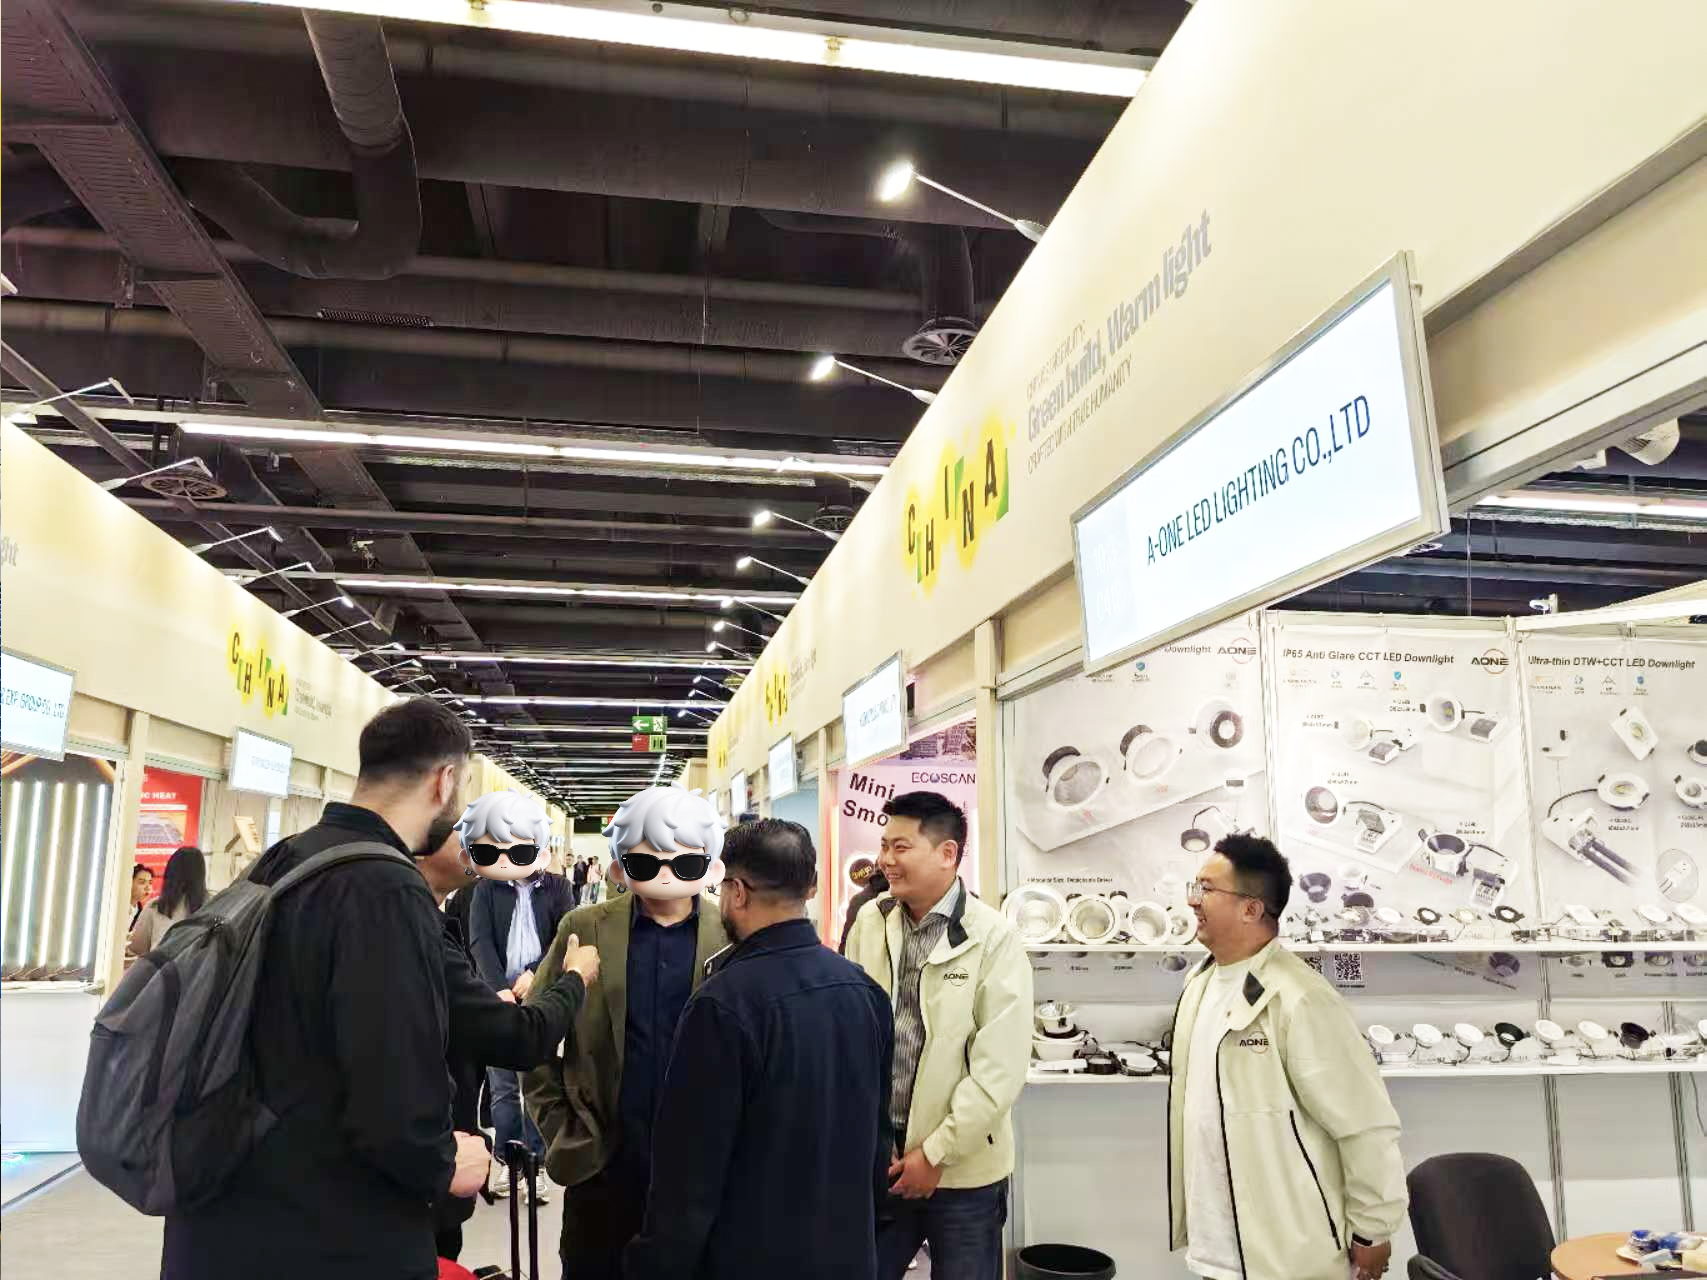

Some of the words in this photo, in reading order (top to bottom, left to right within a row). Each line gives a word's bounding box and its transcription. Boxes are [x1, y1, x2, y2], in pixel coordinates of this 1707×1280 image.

[1107, 272, 1160, 354] Warm
[1163, 208, 1211, 300] light
[908, 438, 998, 577] CHINA
[1147, 514, 1184, 566] A-ONE
[1186, 497, 1212, 541] LED
[1214, 447, 1290, 523] LIGHTING
[1283, 648, 1303, 659] IP65
[1328, 650, 1356, 661] Glare
[1358, 651, 1381, 661] CCT
[1383, 652, 1402, 662] LED
[1404, 653, 1455, 665] Downlight
[1471, 657, 1510, 666] AONE
[1528, 655, 1571, 666] Ultra-thin
[1573, 657, 1624, 668] DTW+CCT
[1626, 658, 1646, 668] LED
[1647, 659, 1696, 670] Downlight
[232, 632, 285, 708] CHINA
[849, 773, 896, 800] Mini
[911, 771, 976, 785] ECOSCAN
[1239, 1038, 1269, 1047] AONE
